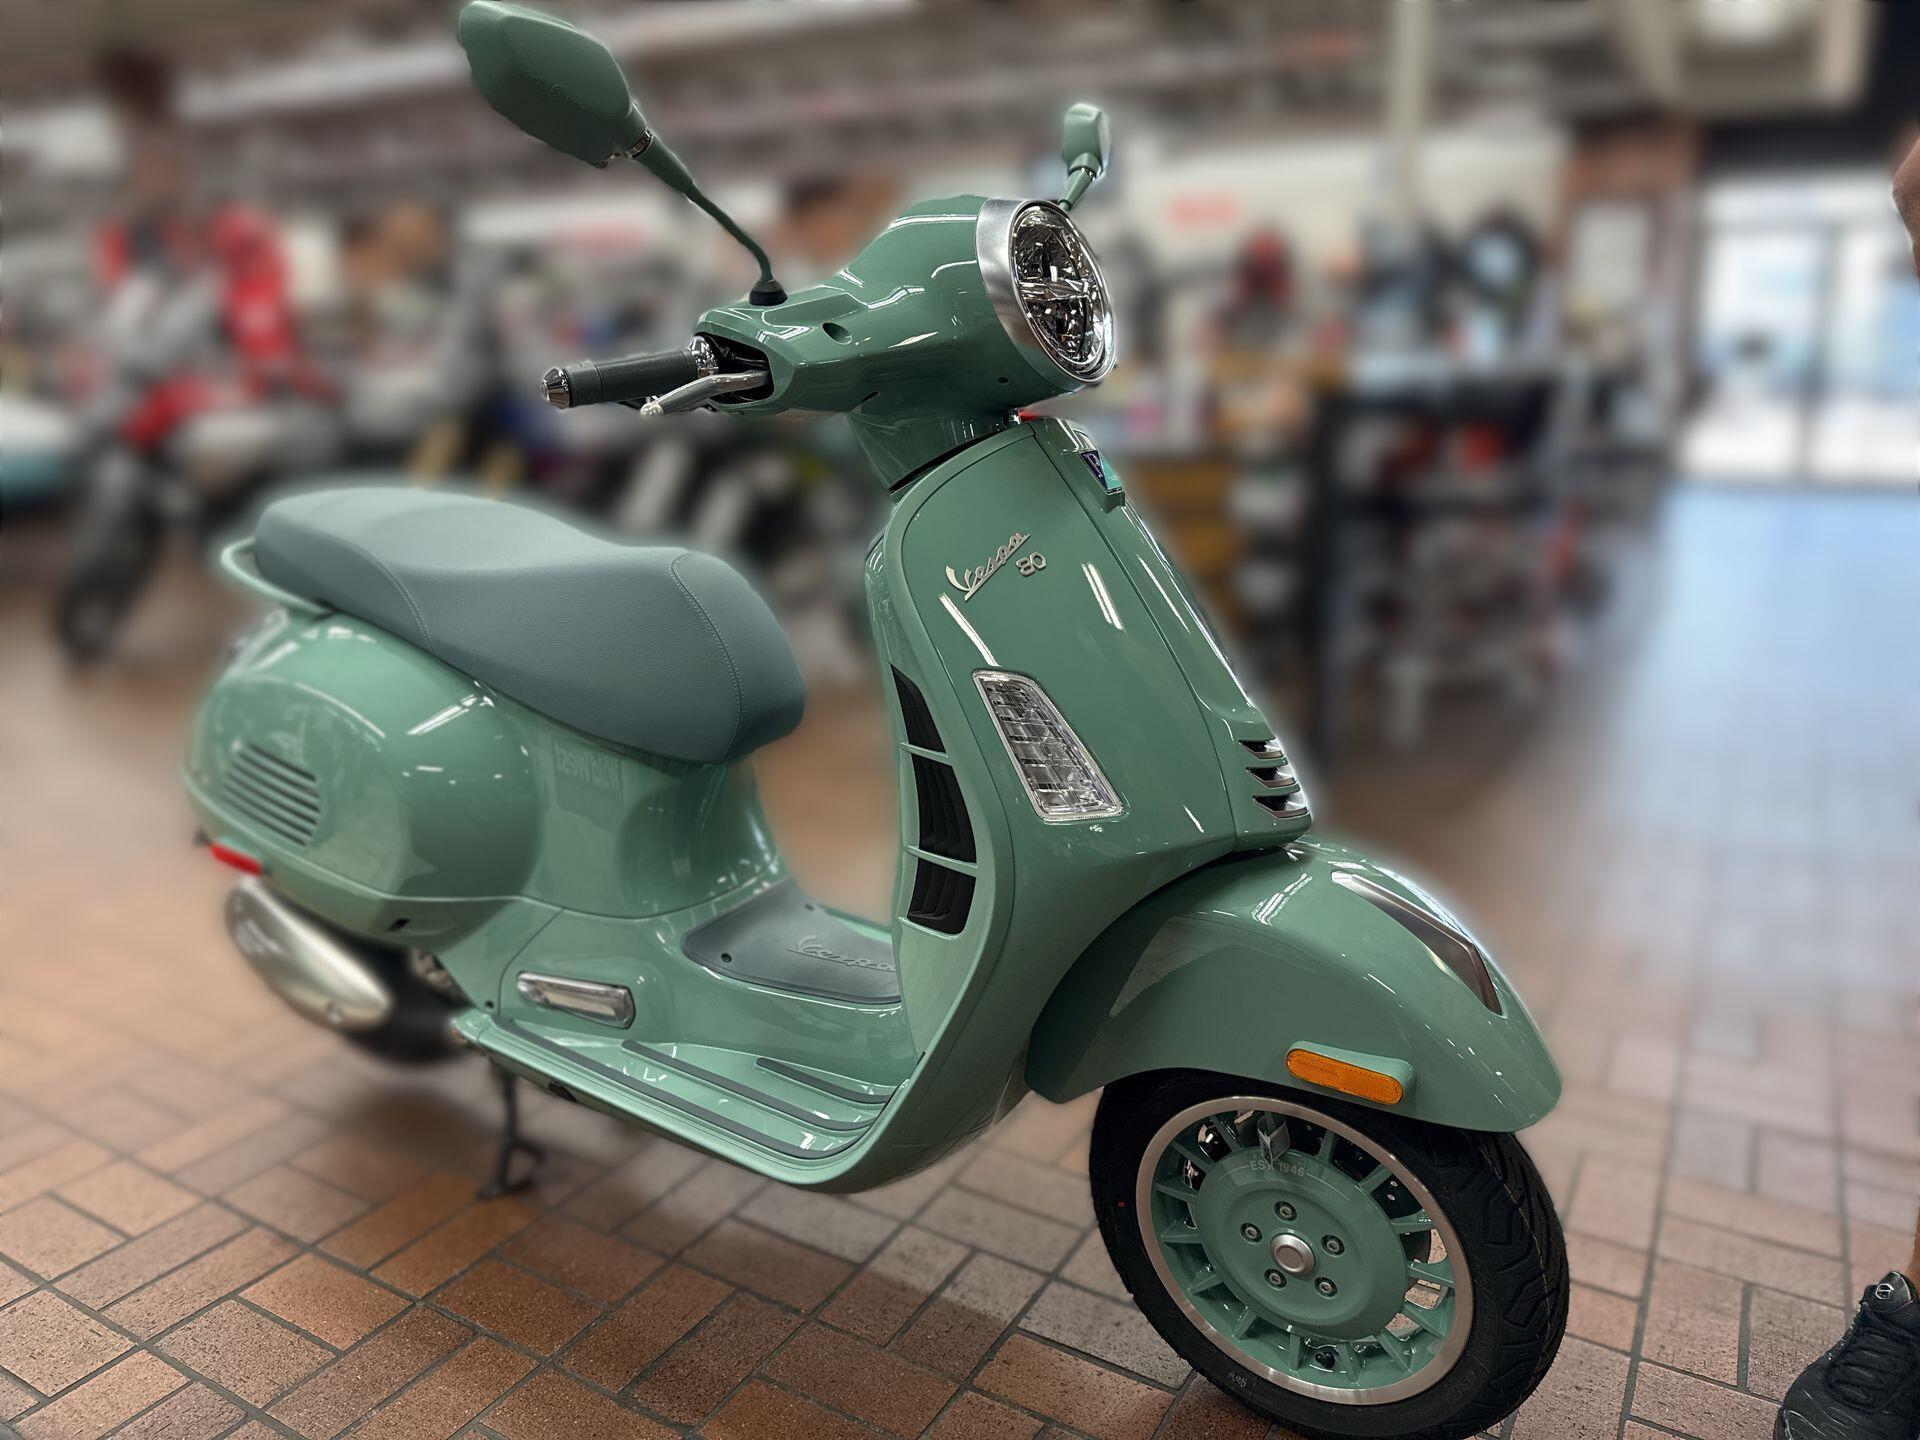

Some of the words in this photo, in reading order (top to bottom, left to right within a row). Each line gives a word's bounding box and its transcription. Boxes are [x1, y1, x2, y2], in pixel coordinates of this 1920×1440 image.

[945, 532, 1031, 602] Vespa
[1016, 552, 1046, 577] 80
[786, 935, 897, 972] Vespa
[1278, 1162, 1305, 1177] 1946
